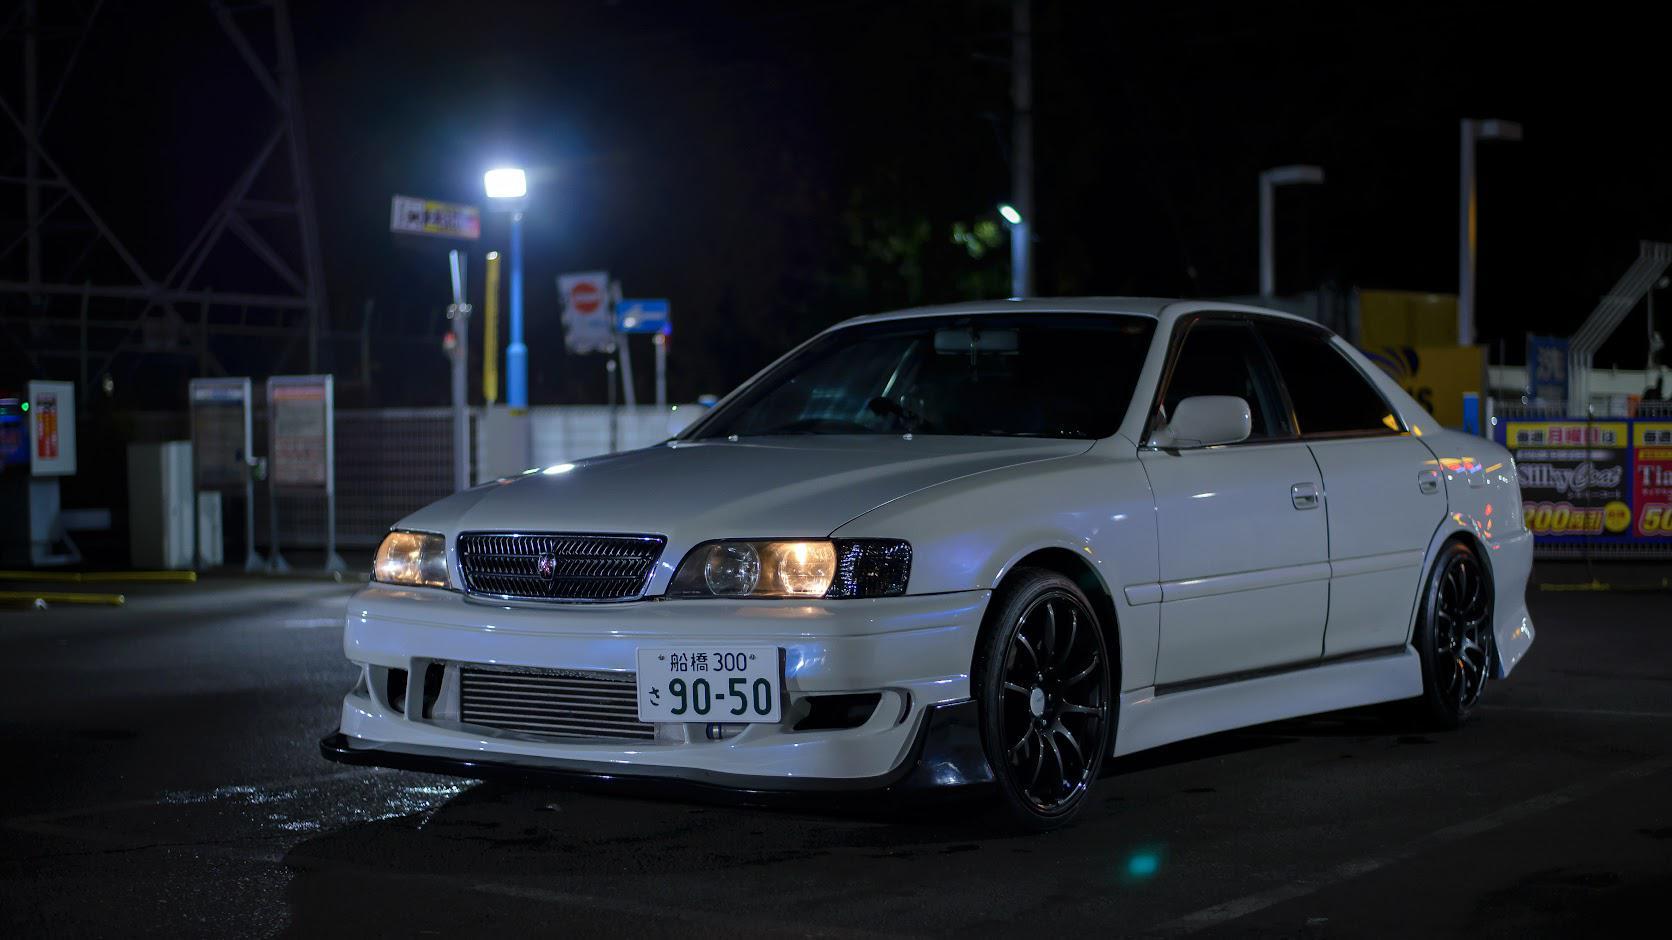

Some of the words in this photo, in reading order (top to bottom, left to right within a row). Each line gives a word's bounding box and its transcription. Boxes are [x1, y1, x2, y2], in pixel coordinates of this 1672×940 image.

[670, 652, 708, 672] 船橋
[713, 652, 747, 672] 300
[648, 686, 660, 706] さ
[668, 677, 772, 715] 90-50
